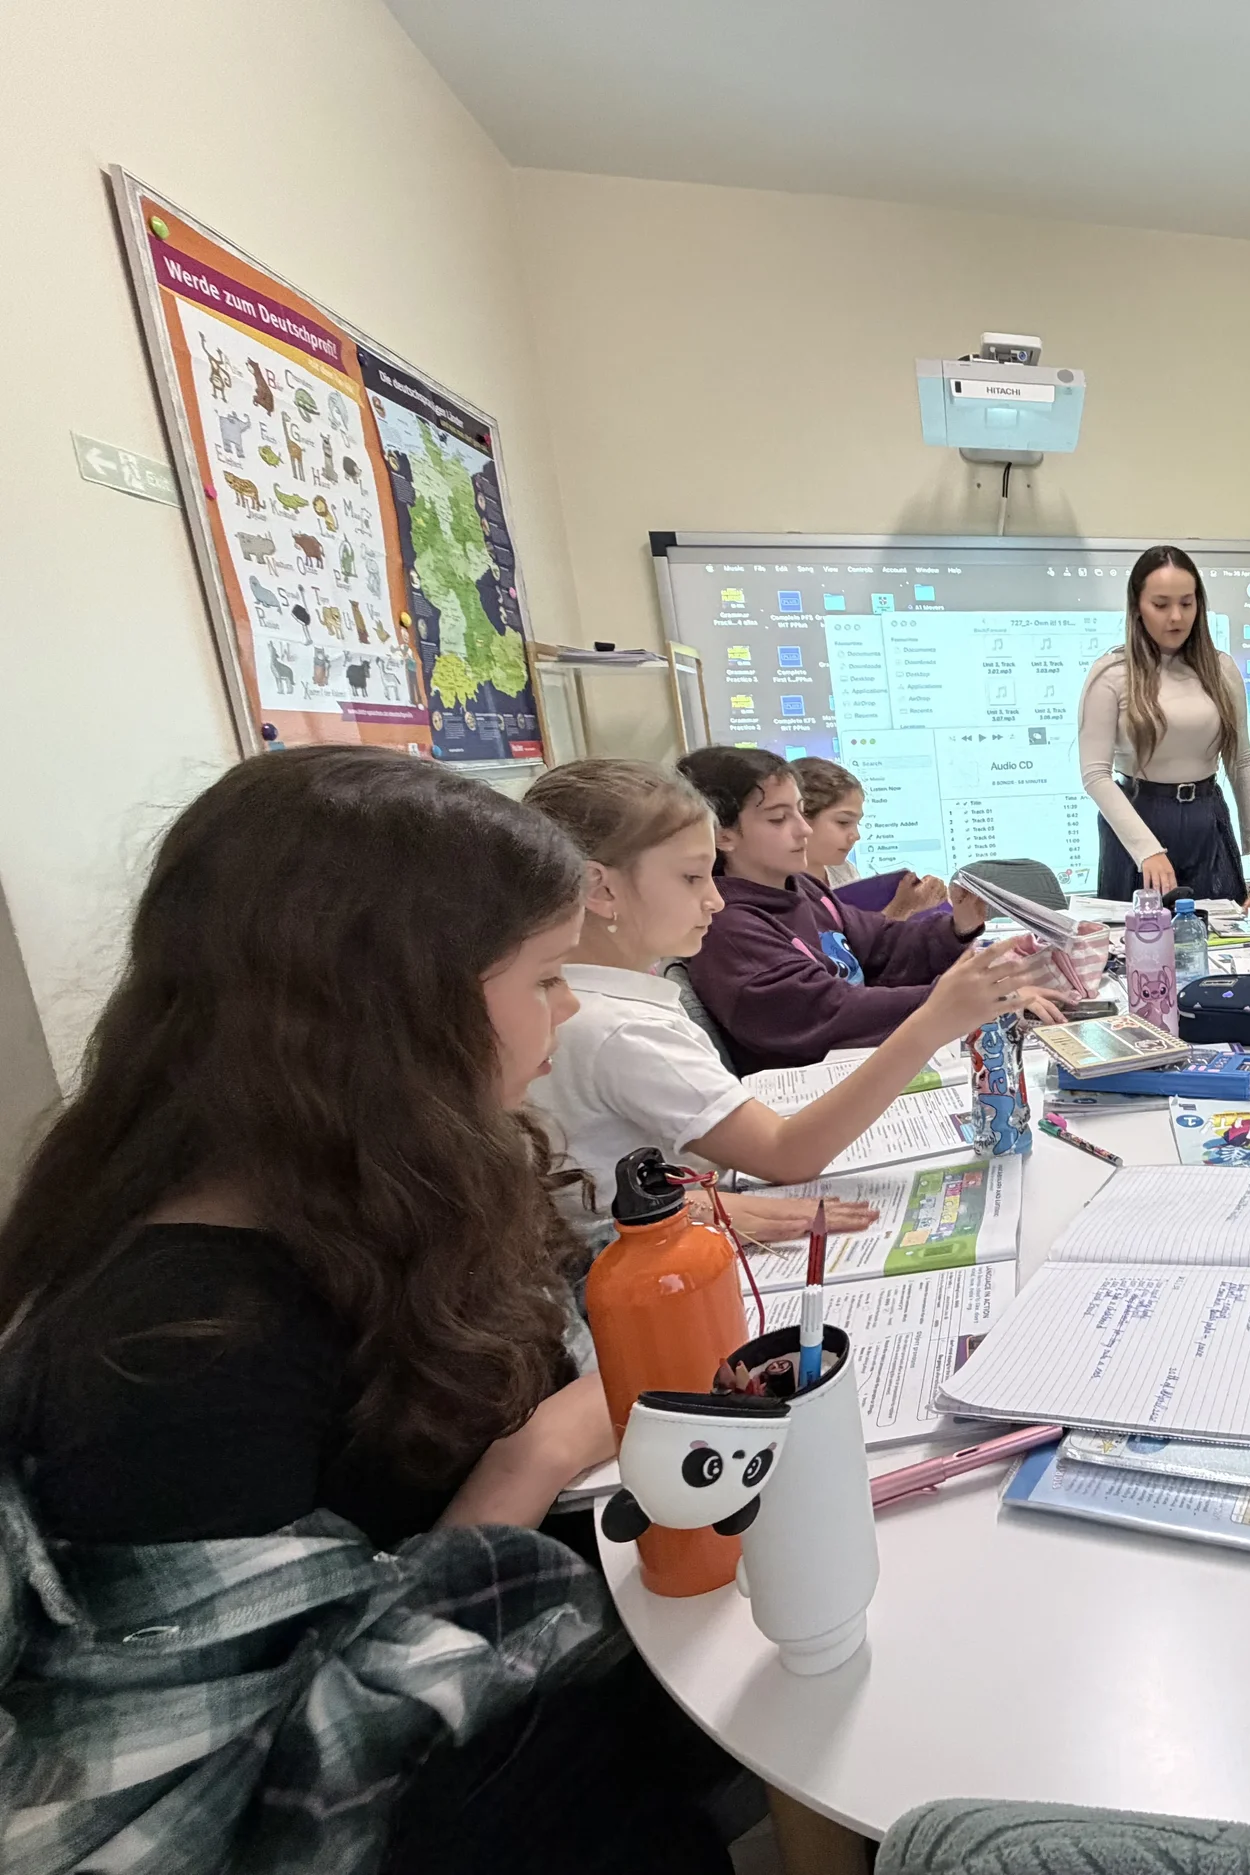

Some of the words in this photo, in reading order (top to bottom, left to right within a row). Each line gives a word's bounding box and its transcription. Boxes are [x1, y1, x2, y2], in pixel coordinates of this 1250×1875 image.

[163, 255, 221, 301] Werde
[222, 289, 257, 319] zum
[257, 302, 339, 360] Deutschprofi!
[378, 369, 393, 387] Die
[986, 386, 1021, 396] HITACHI
[797, 566, 814, 574] Song
[991, 762, 1017, 771] Audio
[1018, 761, 1034, 770] CD
[1183, 1116, 1198, 1127] 1
[982, 1298, 990, 1318] ACTION
